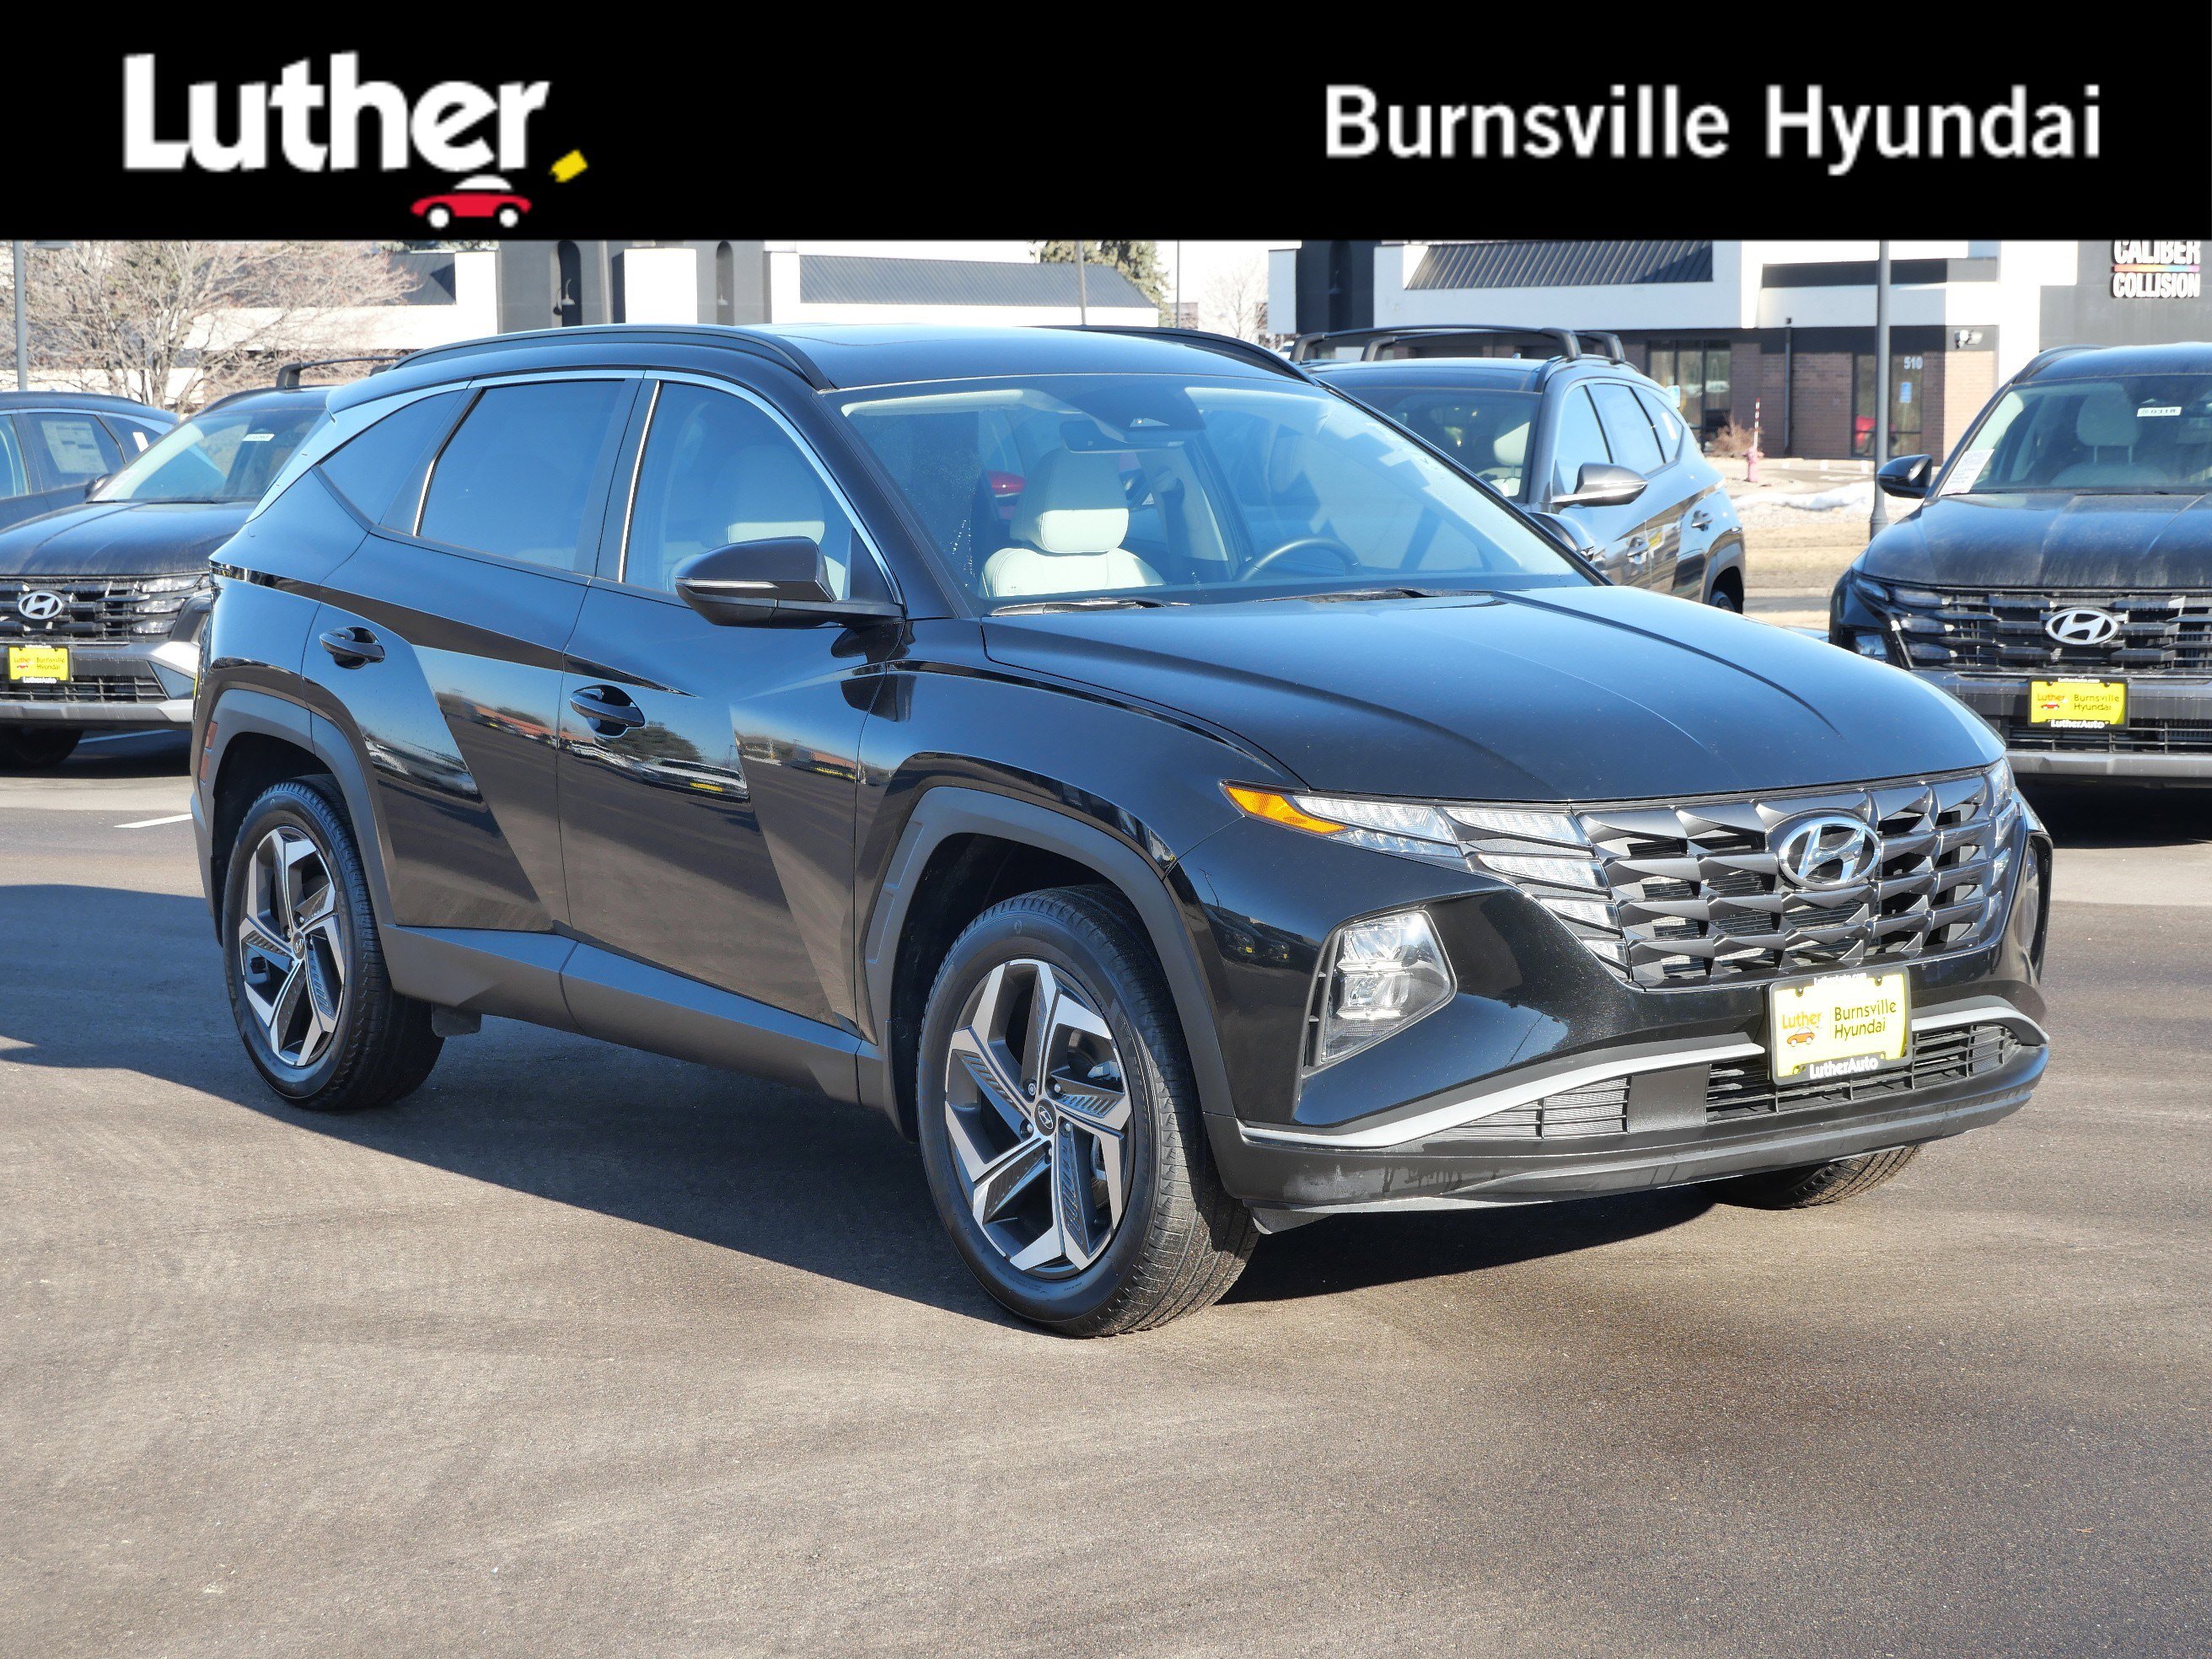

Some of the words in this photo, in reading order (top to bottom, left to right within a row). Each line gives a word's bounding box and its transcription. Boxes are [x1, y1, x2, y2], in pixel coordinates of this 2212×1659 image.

[2113, 239, 2201, 264] CALIBER
[2113, 272, 2200, 298] COLLISION
[1903, 356, 1923, 370] 510
[2037, 693, 2065, 701] Luther
[2074, 694, 2120, 702] Burnsville
[2074, 702, 2112, 711] Hyundai
[2050, 719, 2106, 729] LutherAuto
[1834, 998, 1897, 1022] Burnsville
[1781, 1011, 1823, 1030] Luther
[1834, 1017, 1887, 1041] Hyundai
[1809, 1055, 1879, 1080] LutherAuto
